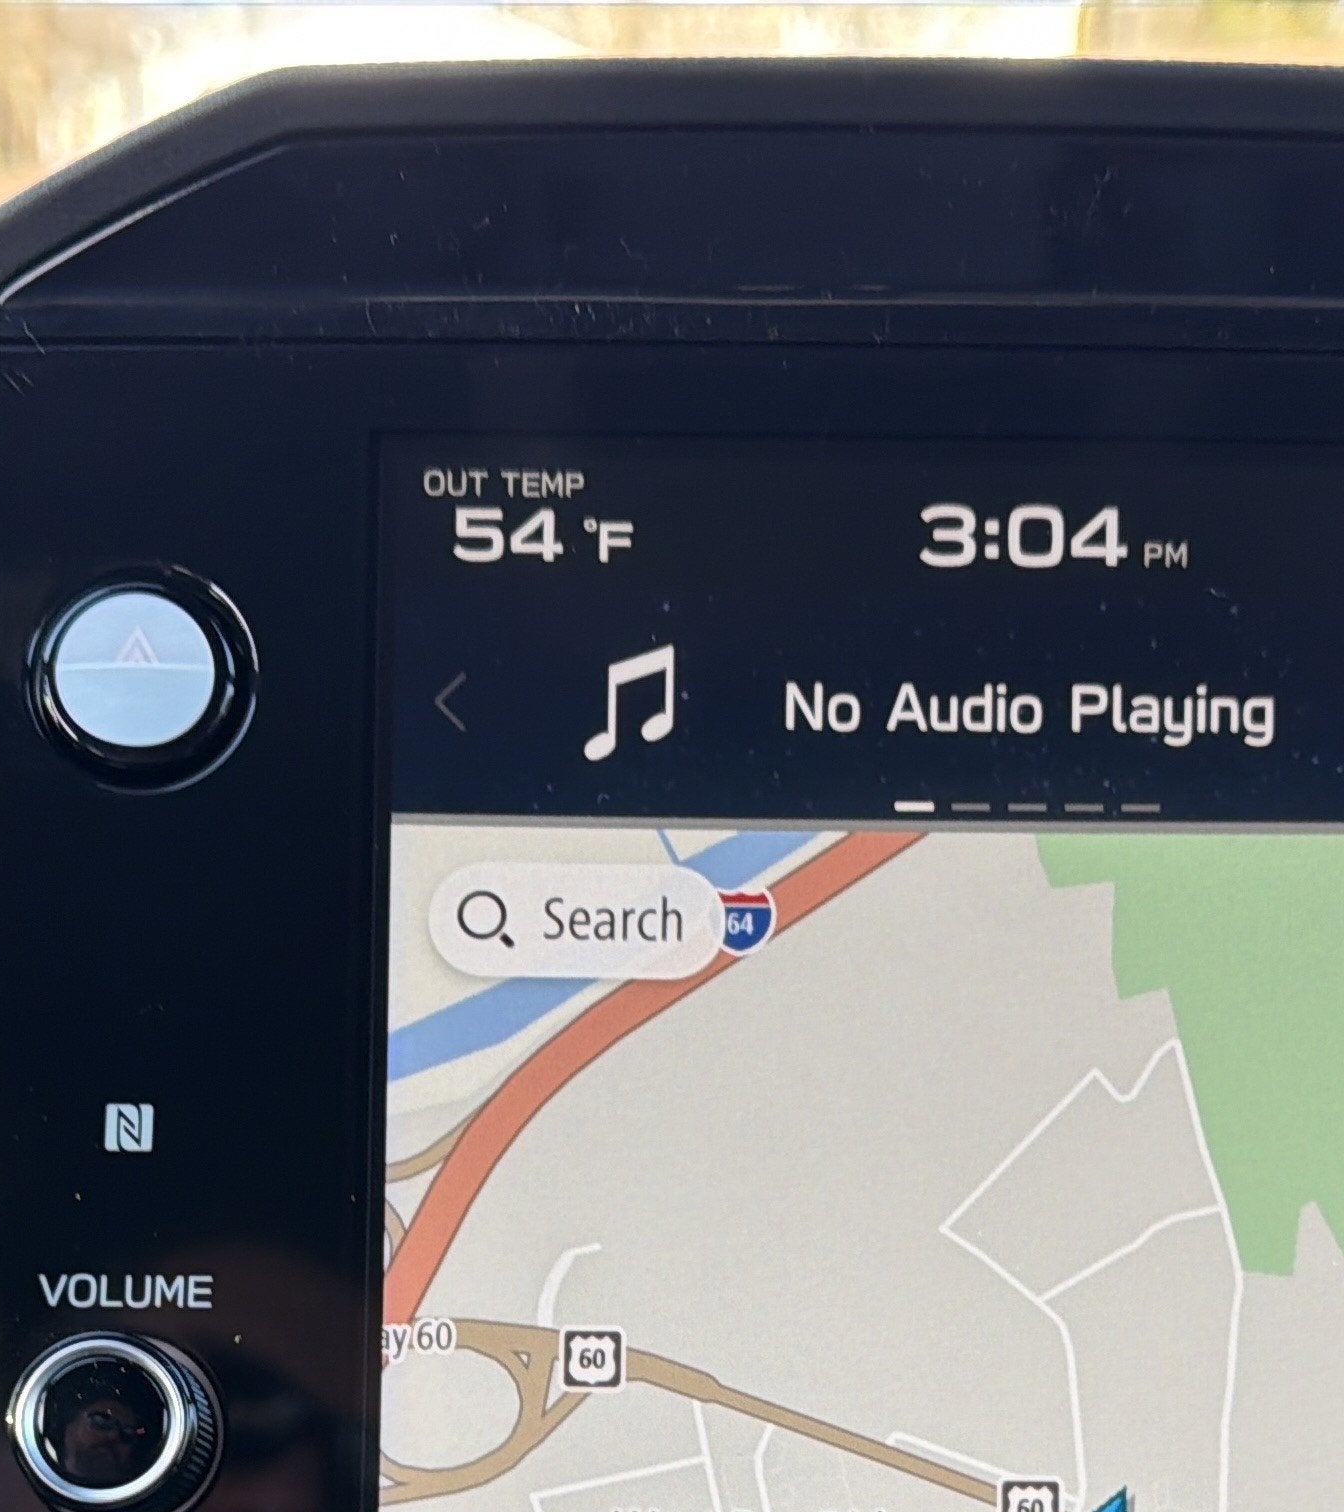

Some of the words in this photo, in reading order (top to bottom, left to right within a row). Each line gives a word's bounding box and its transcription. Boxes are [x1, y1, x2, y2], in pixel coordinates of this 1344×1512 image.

[423, 469, 487, 498] OUT
[501, 470, 585, 498] TEMP
[453, 506, 564, 563] 54
[919, 503, 1128, 568] 3:04
[1143, 541, 1189, 569] PM
[784, 682, 861, 734] No
[886, 682, 1044, 734] Audio
[1070, 683, 1276, 747] Playing
[542, 897, 684, 943] Search
[727, 911, 755, 937] 64
[38, 1273, 214, 1309] VOLUME
[416, 1320, 454, 1351] 60
[578, 1347, 607, 1370] 60
